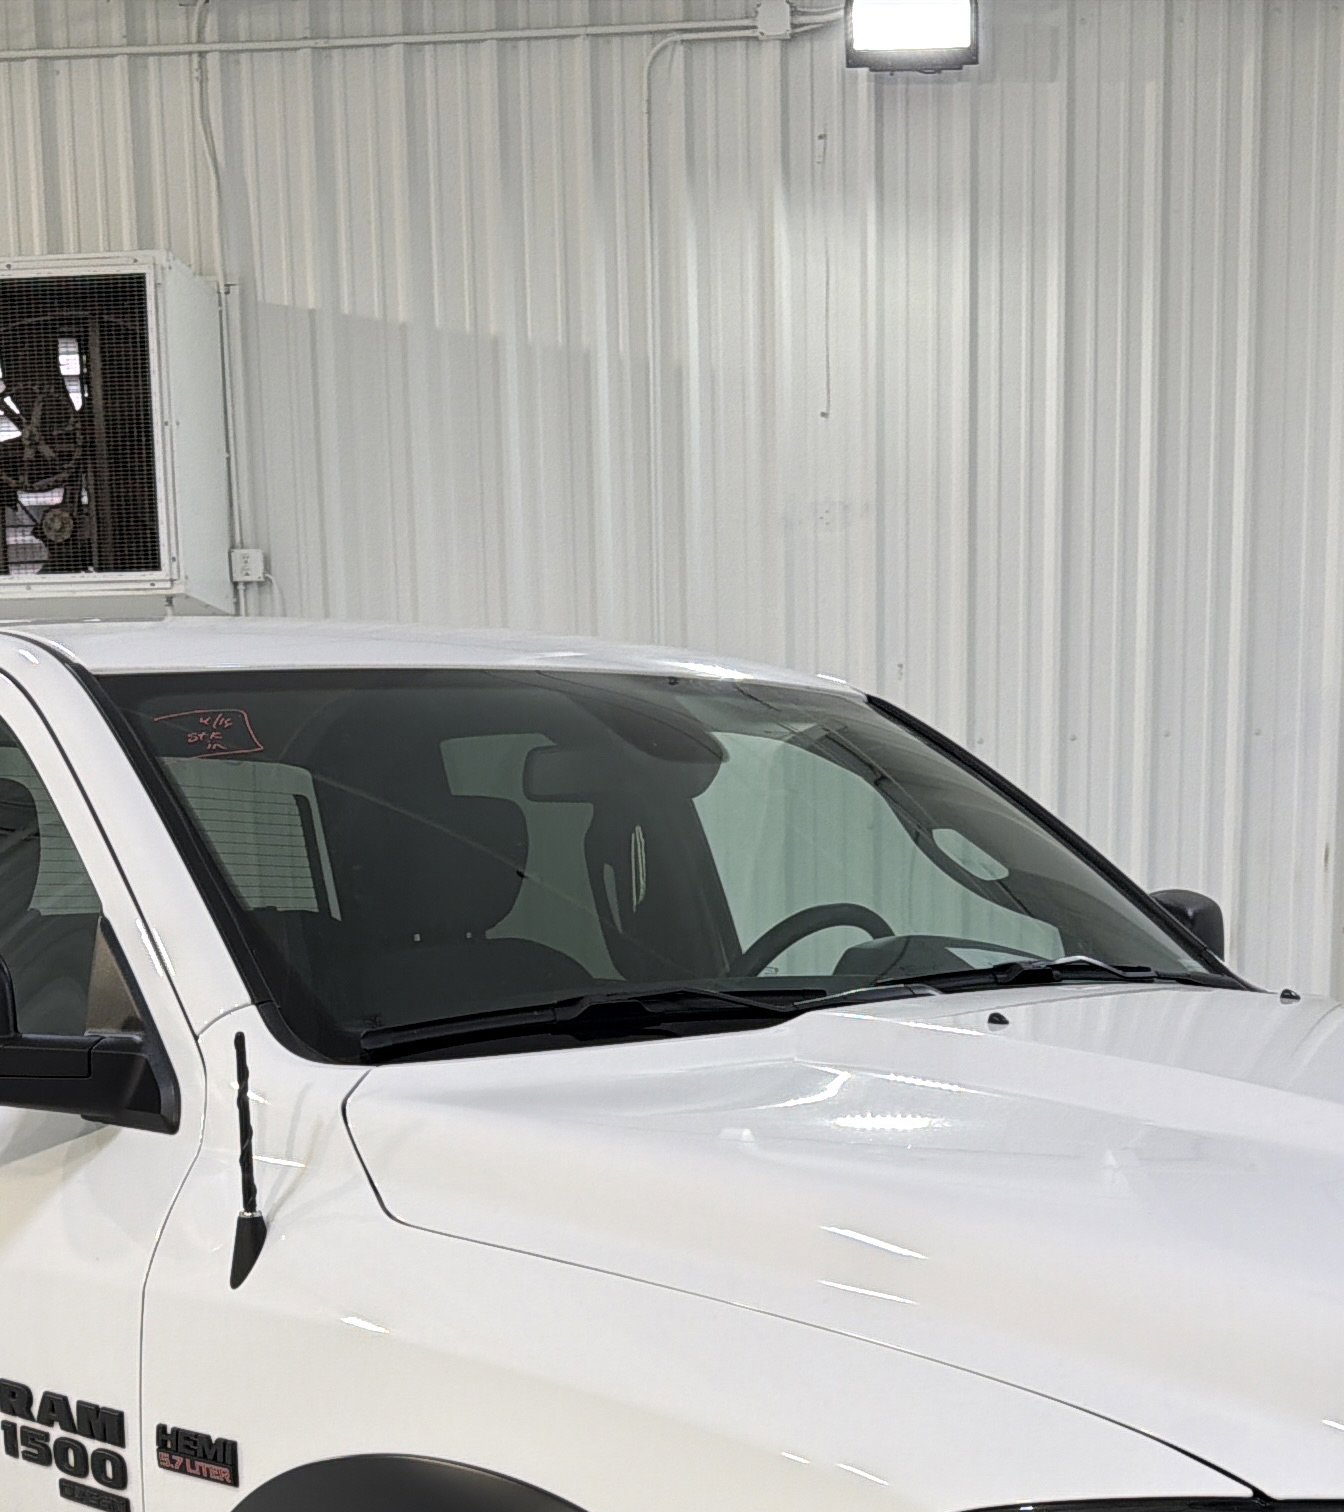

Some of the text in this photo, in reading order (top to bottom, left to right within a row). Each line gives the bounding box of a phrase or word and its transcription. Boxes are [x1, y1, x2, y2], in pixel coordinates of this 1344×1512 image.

[1, 1420, 128, 1490] 1500
[156, 1423, 238, 1465] HEMI
[159, 1452, 233, 1484] 5.7 LITER
